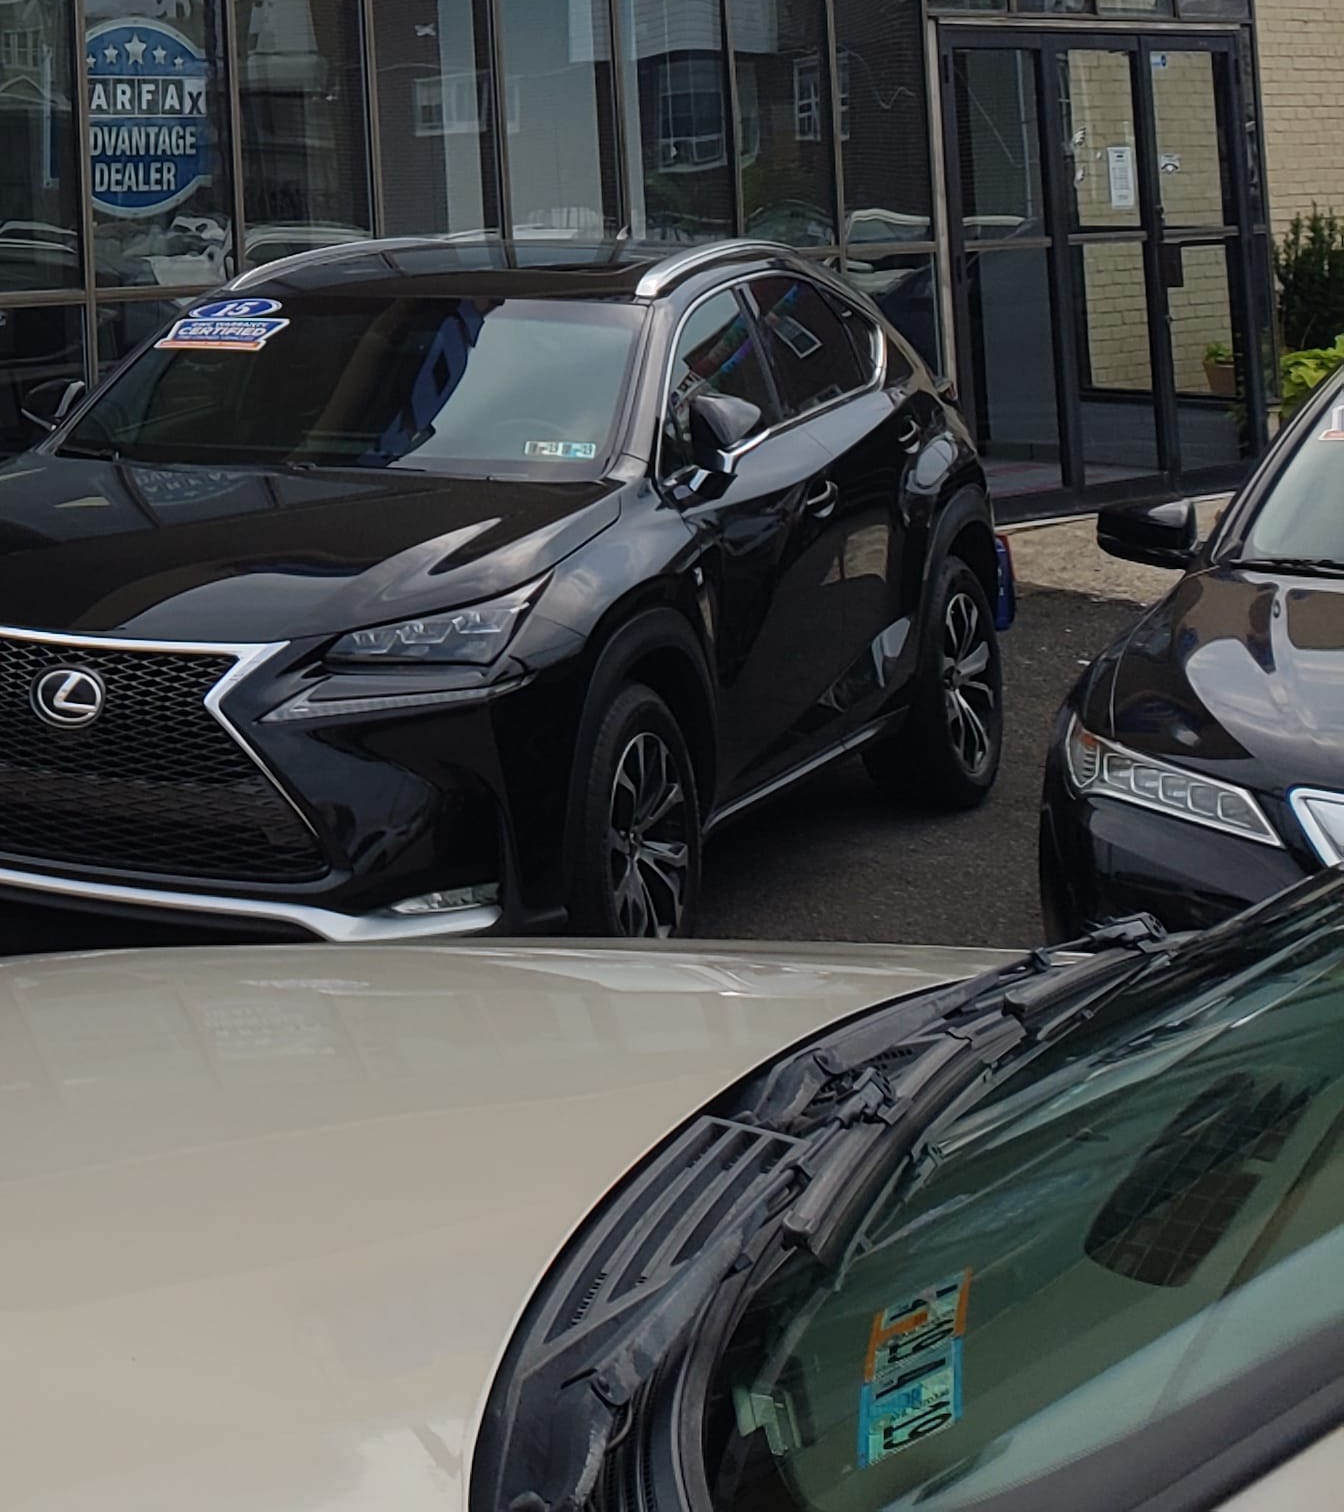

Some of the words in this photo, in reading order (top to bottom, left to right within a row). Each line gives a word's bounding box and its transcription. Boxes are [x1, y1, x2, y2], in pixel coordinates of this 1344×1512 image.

[90, 83, 204, 115] ARFAX
[89, 125, 197, 156] DVANTAGE
[95, 162, 176, 192] DEALER
[210, 301, 260, 317] 15
[178, 327, 267, 337] CERTIFIED
